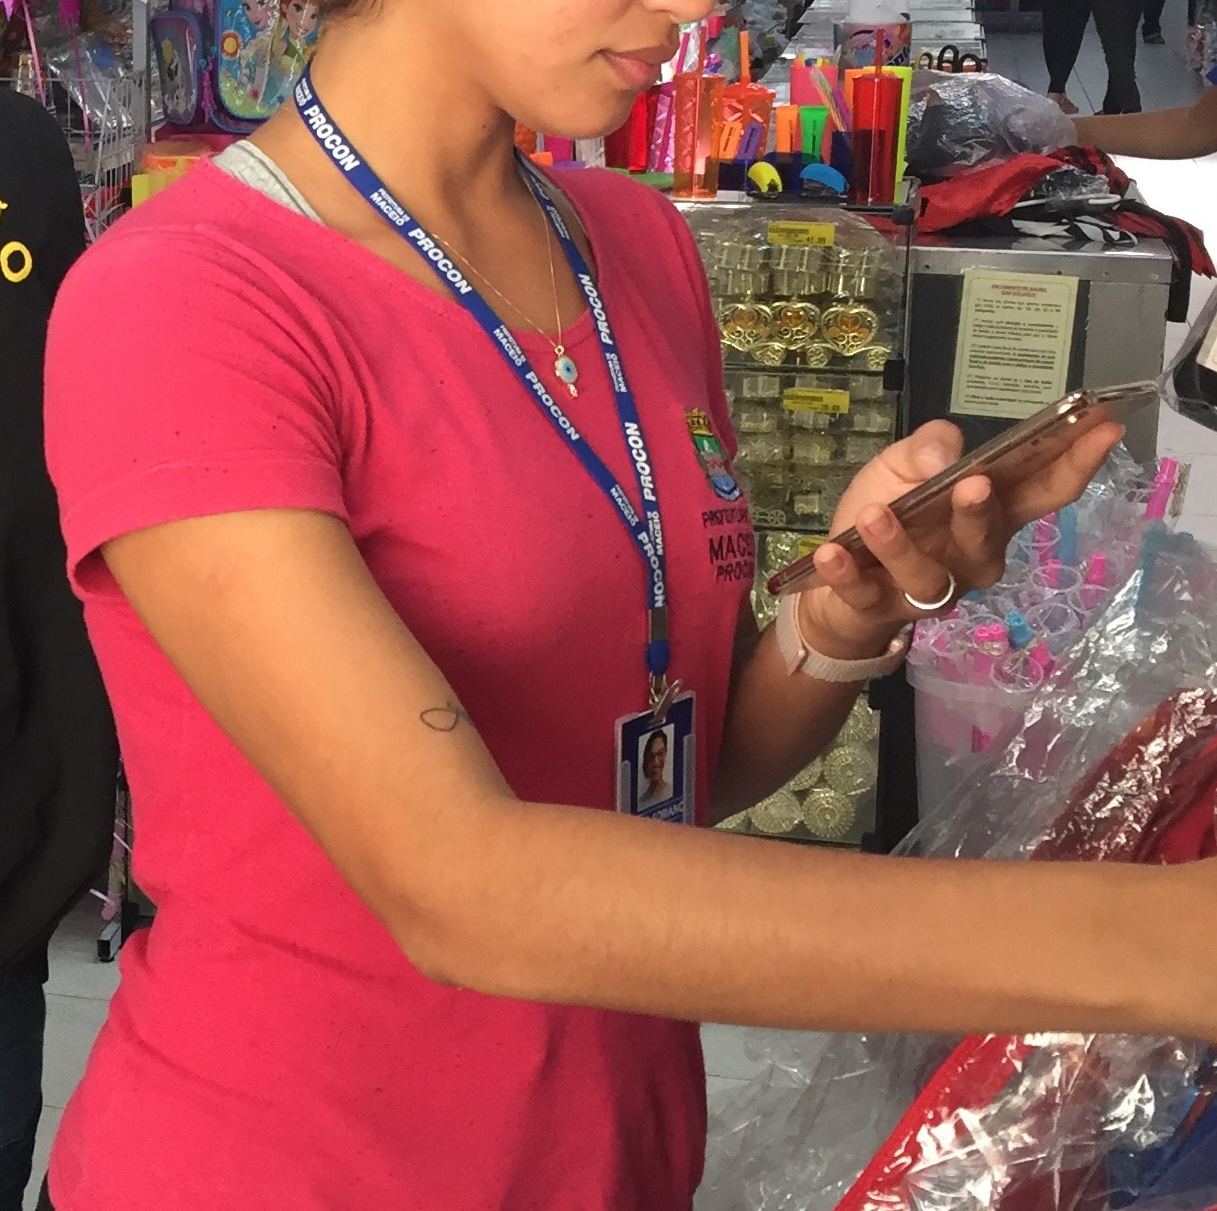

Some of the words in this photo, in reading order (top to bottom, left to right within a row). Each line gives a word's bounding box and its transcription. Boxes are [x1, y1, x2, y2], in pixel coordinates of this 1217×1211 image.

[303, 104, 360, 172] PROCON
[408, 227, 472, 294] PROCON
[578, 273, 614, 345] PROCON
[525, 370, 580, 441] PROCON
[624, 422, 656, 502] PROCON
[637, 531, 665, 608] PROCON
